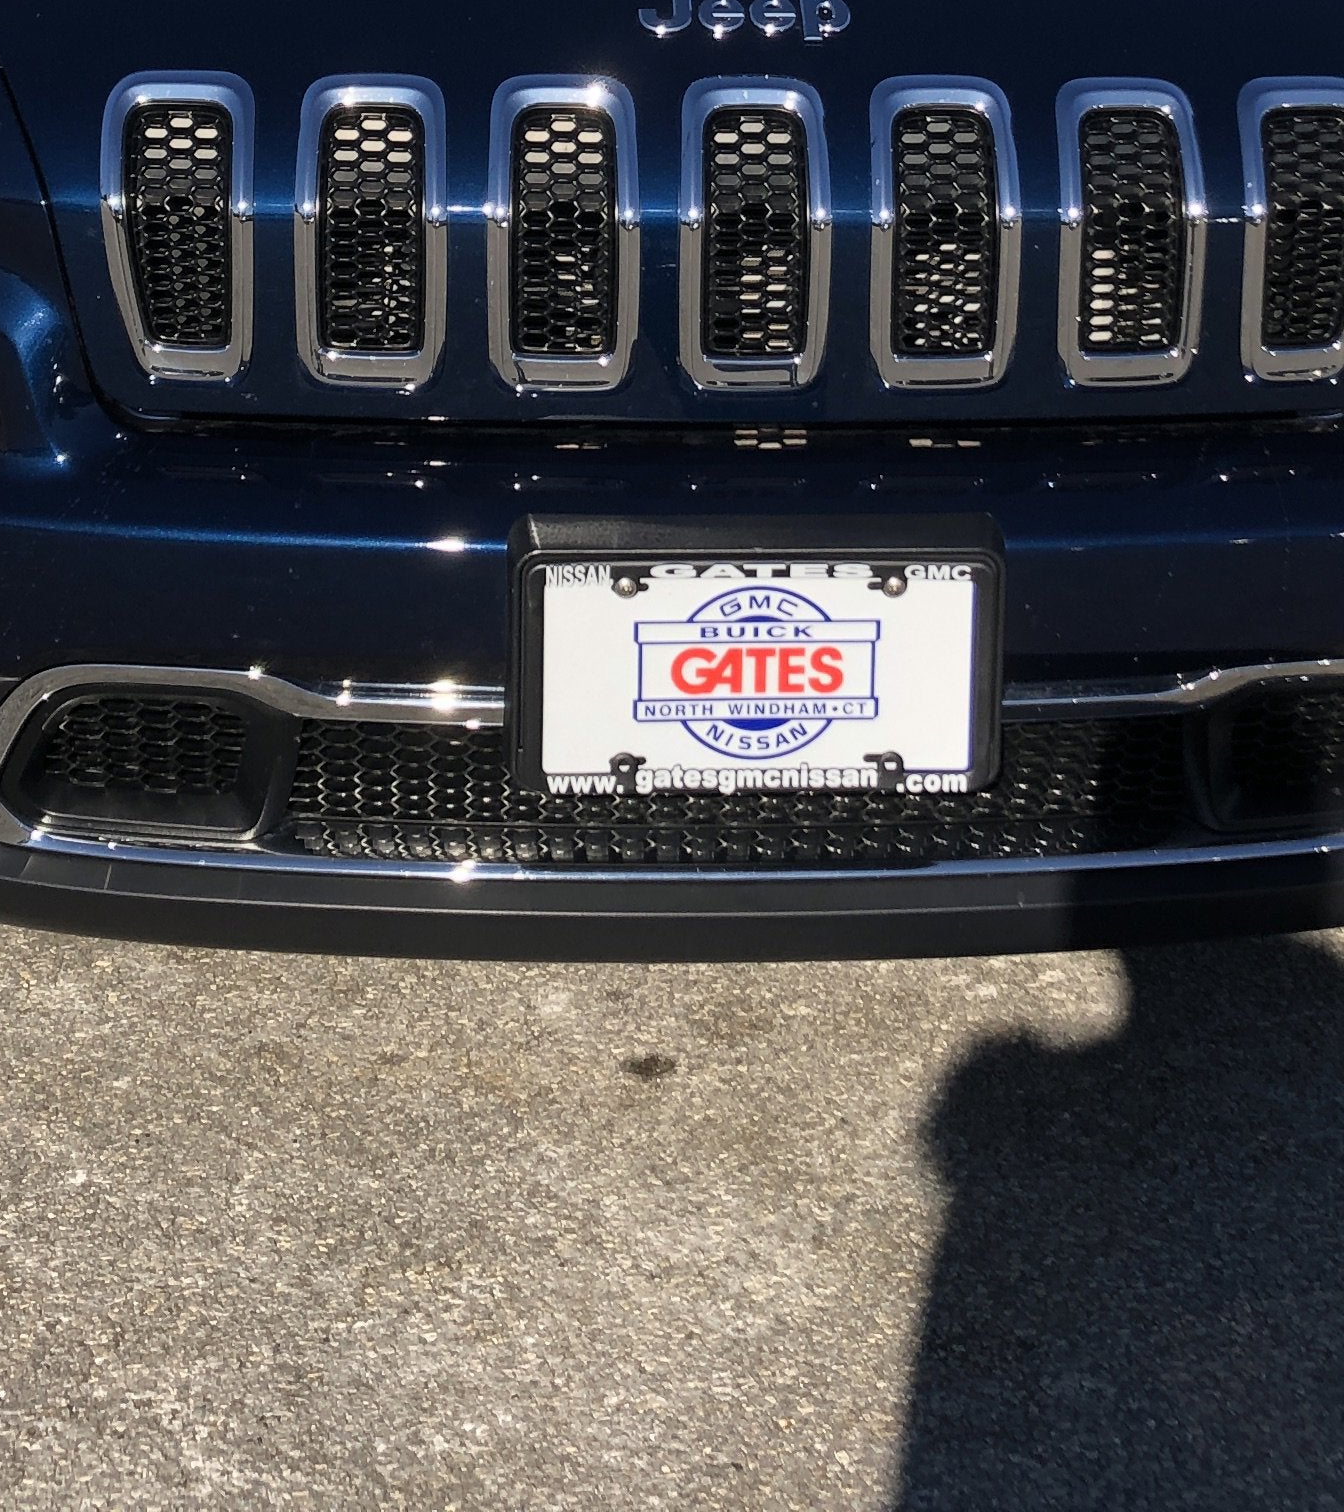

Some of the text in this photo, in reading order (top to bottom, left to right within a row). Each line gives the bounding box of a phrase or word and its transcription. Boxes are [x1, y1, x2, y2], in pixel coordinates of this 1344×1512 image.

[545, 564, 611, 587] NISSAN
[650, 563, 874, 579] GATES
[904, 564, 971, 580] GMC
[719, 595, 798, 617] GMC
[700, 626, 813, 639] BUICK
[670, 646, 844, 695] GATES
[644, 704, 713, 717] NORTH
[706, 722, 808, 751] NISSAN
